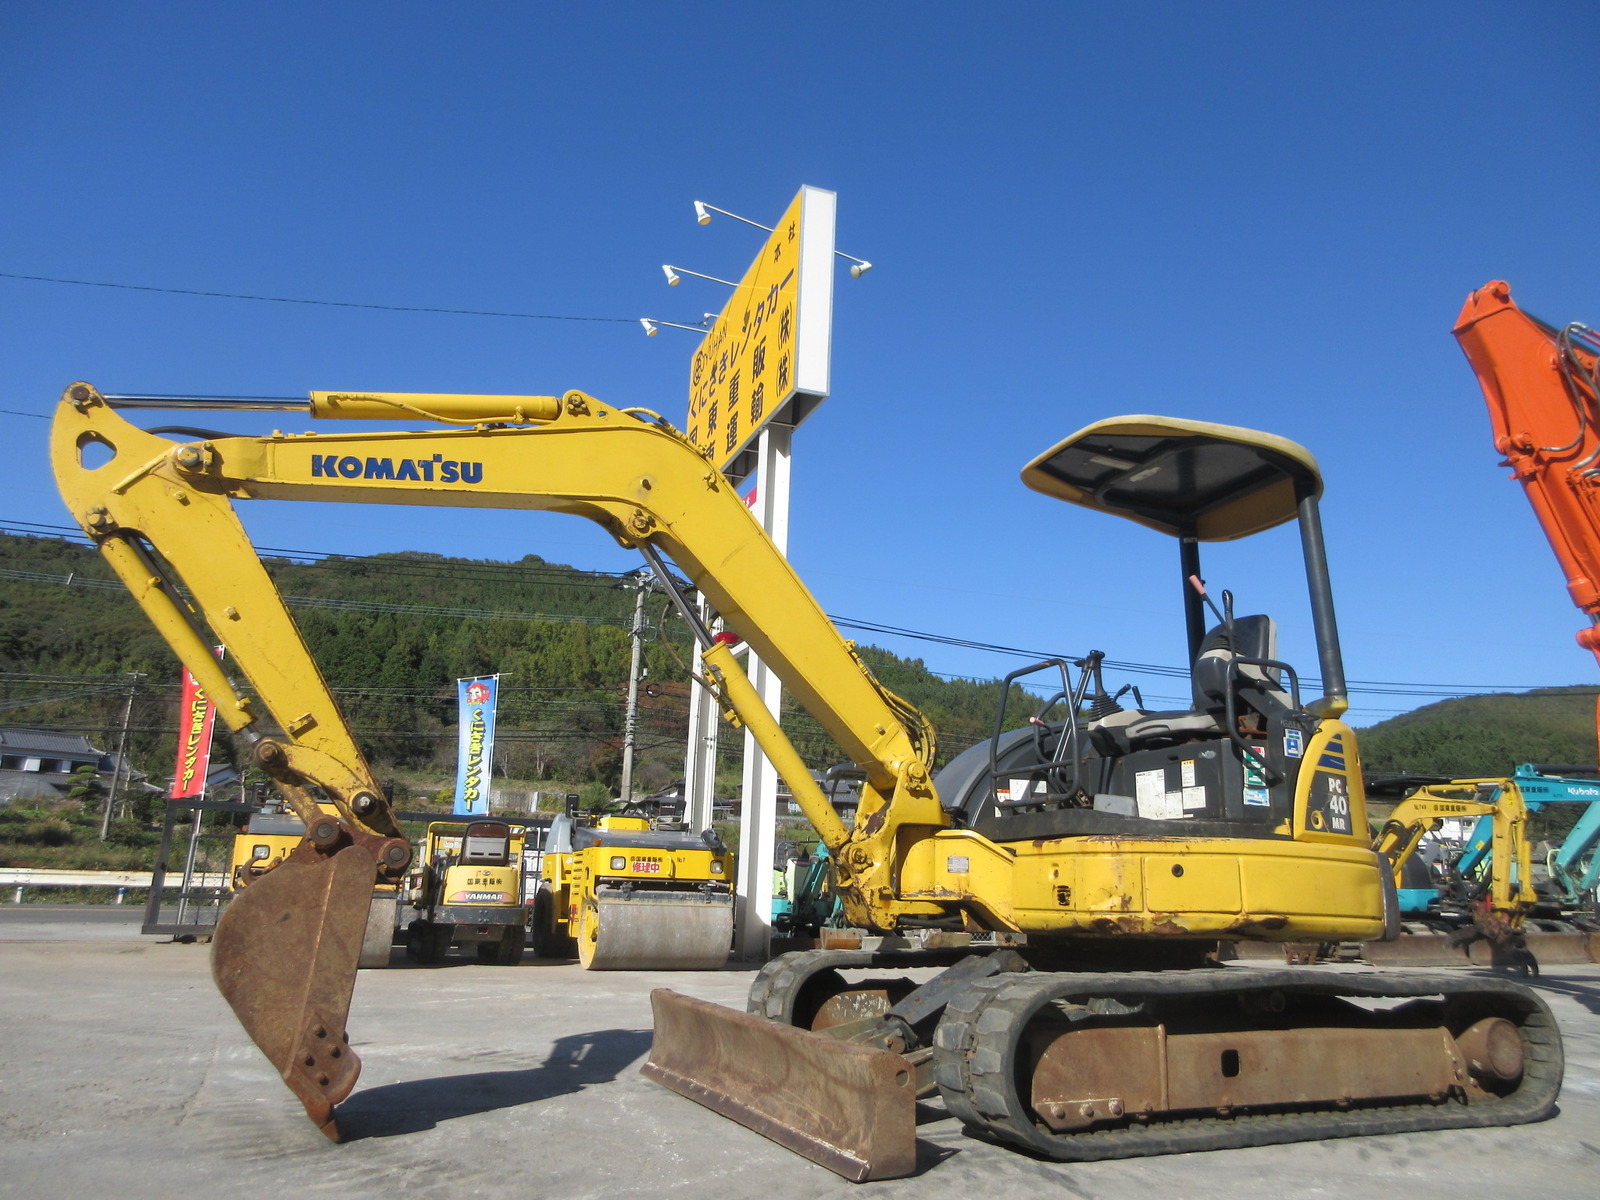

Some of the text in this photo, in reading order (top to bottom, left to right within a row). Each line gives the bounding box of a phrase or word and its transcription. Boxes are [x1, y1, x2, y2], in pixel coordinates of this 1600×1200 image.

[774, 221, 795, 264] 本社
[312, 454, 483, 484] KOMATSU
[463, 708, 486, 812] くにさきレンタカー
[1328, 777, 1342, 794] PC
[1330, 795, 1347, 815] 40
[1332, 816, 1346, 830] MR
[633, 862, 660, 873] 修理中
